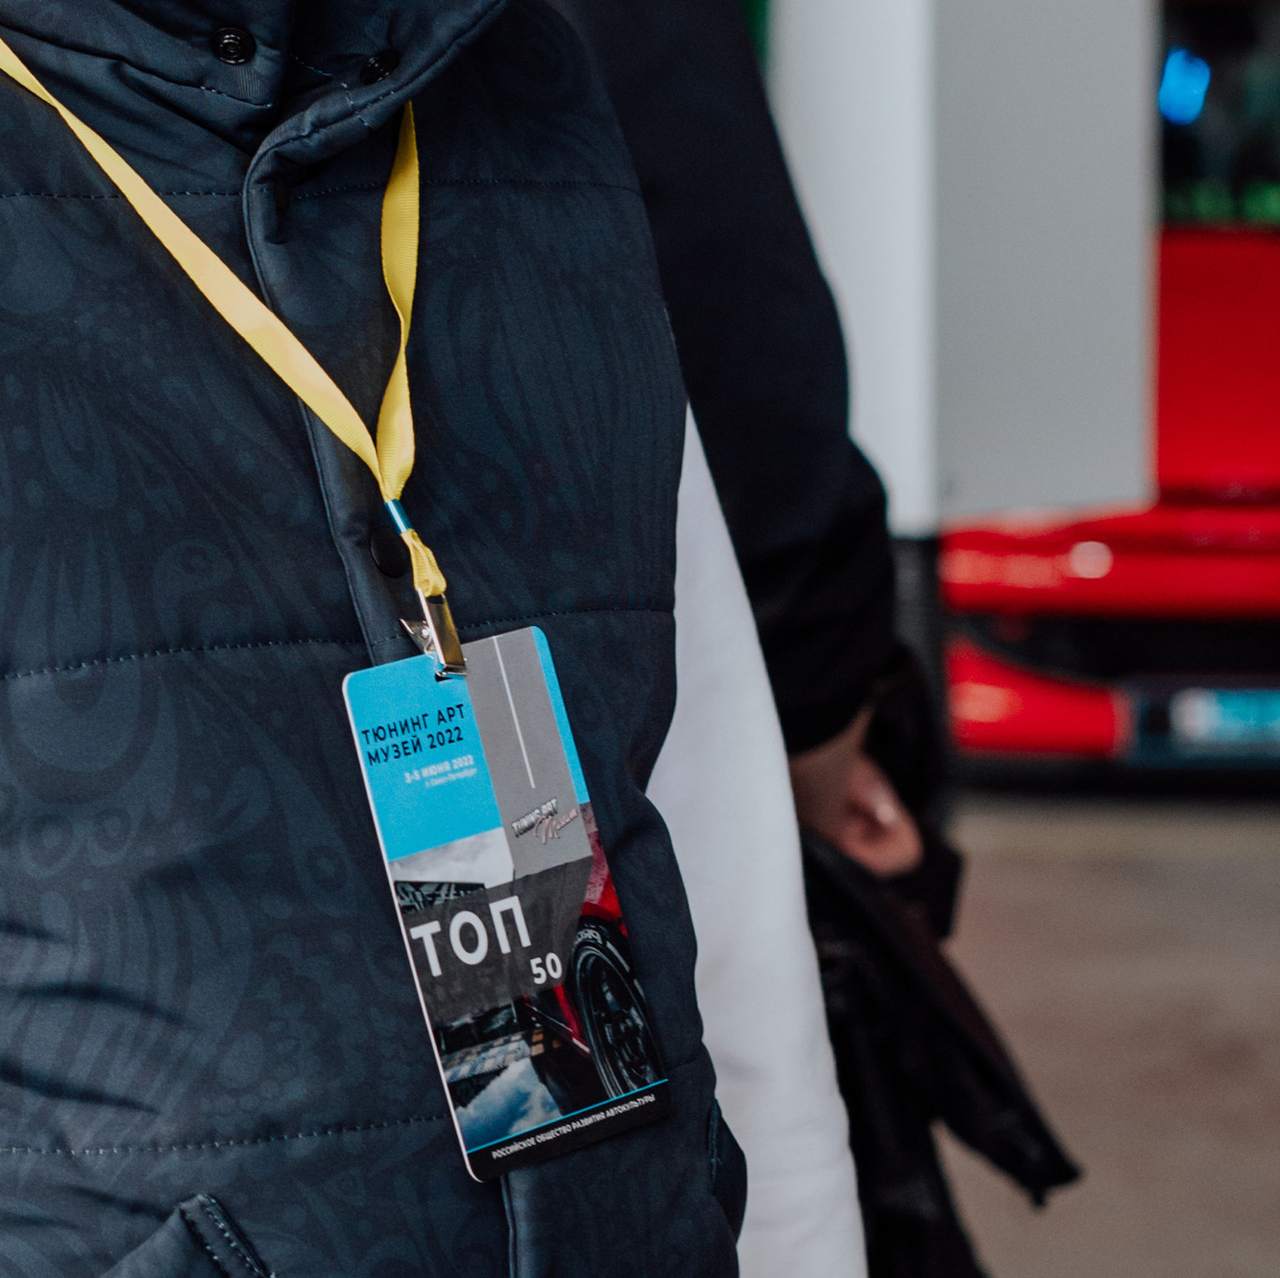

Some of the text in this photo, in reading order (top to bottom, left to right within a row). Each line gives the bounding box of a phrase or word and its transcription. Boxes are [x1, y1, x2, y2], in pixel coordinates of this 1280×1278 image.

[361, 703, 464, 745] ТЮНИНГ АРТ
[367, 726, 464, 766] МУЗЕЙ 2022
[409, 895, 531, 978] ТОП
[529, 952, 563, 985] 50
